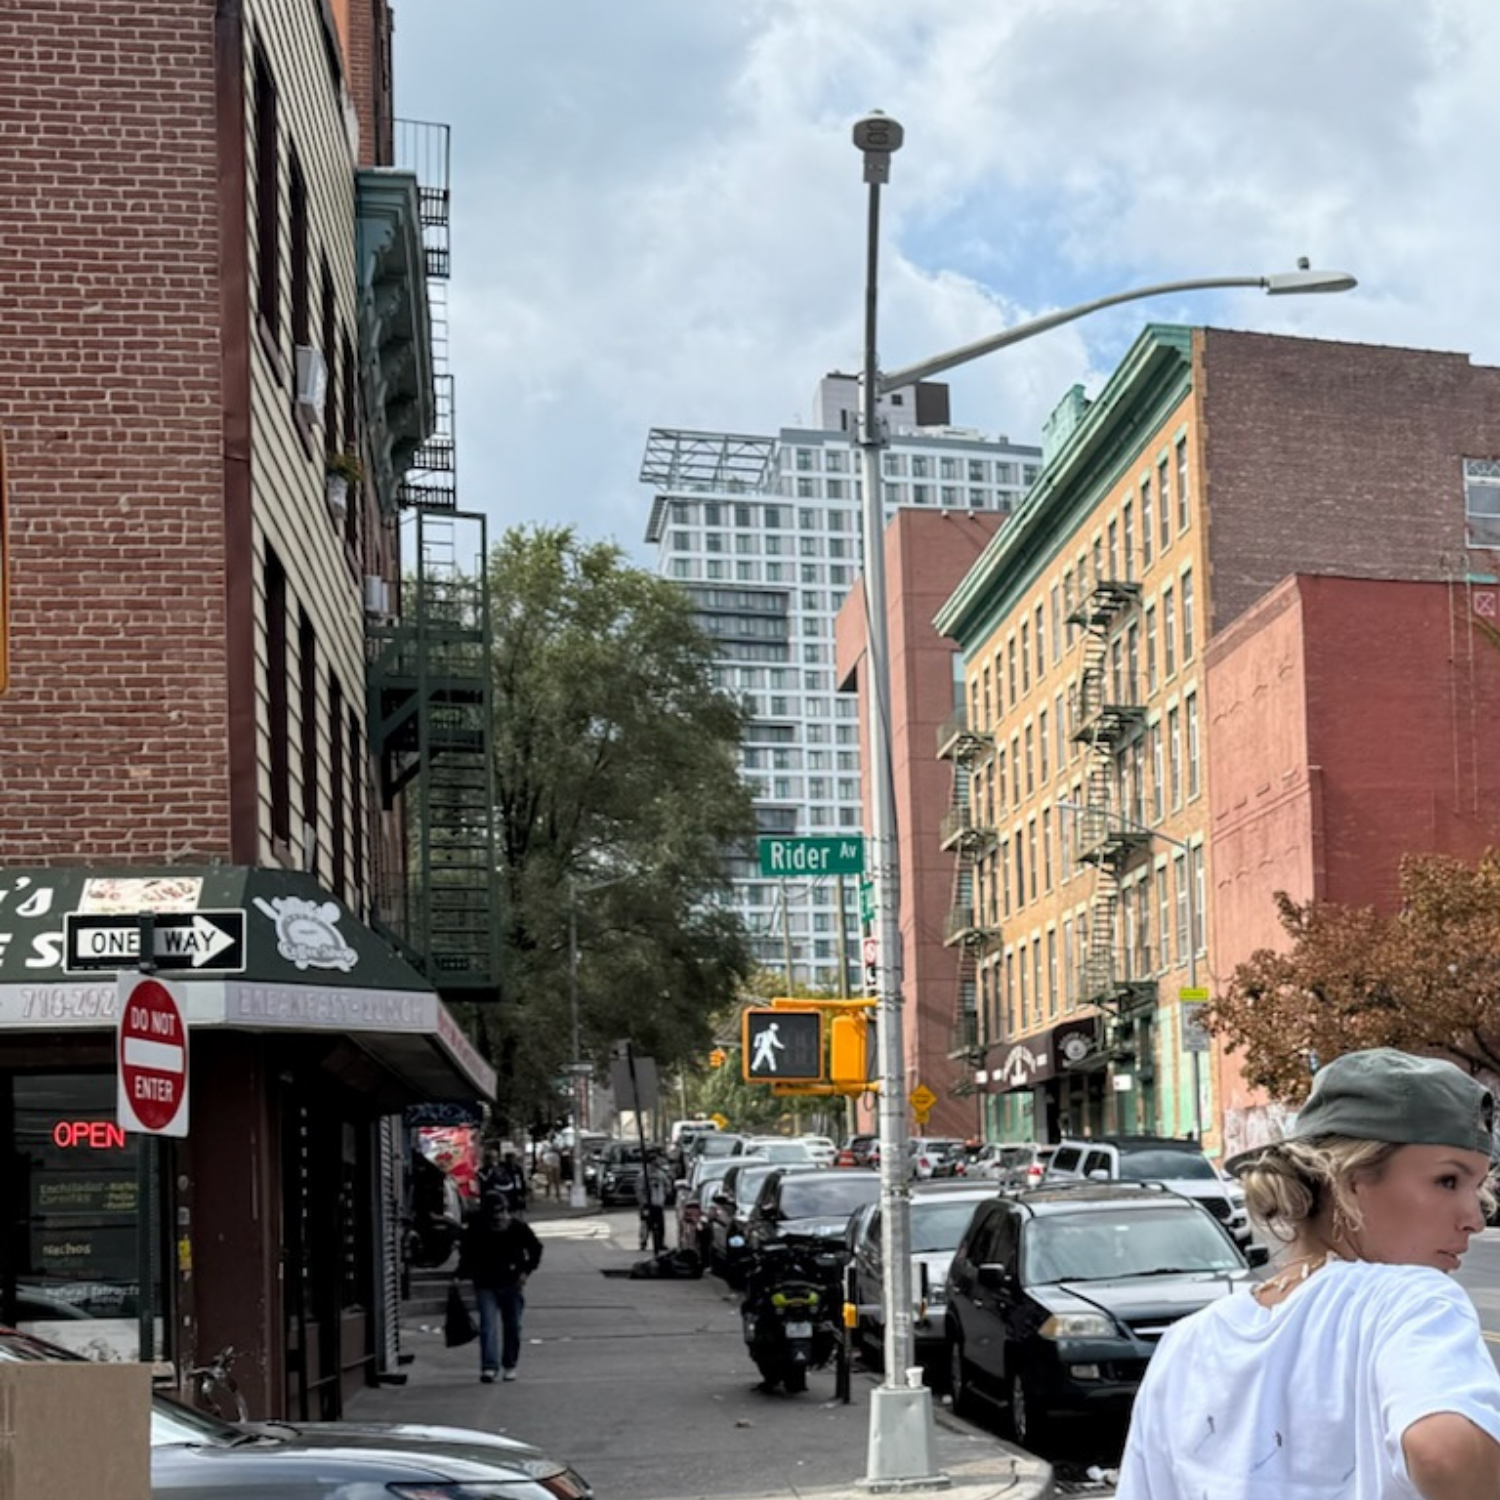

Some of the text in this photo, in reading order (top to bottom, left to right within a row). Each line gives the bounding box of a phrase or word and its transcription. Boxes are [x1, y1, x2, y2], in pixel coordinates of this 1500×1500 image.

[770, 841, 858, 870] Rider Av
[0, 876, 54, 918] 's
[25, 931, 63, 968] S
[91, 930, 216, 954] ONE WAY
[130, 1007, 176, 1036] DO NOT
[134, 1075, 174, 1103] ENTER
[53, 1121, 126, 1149] OPEN
